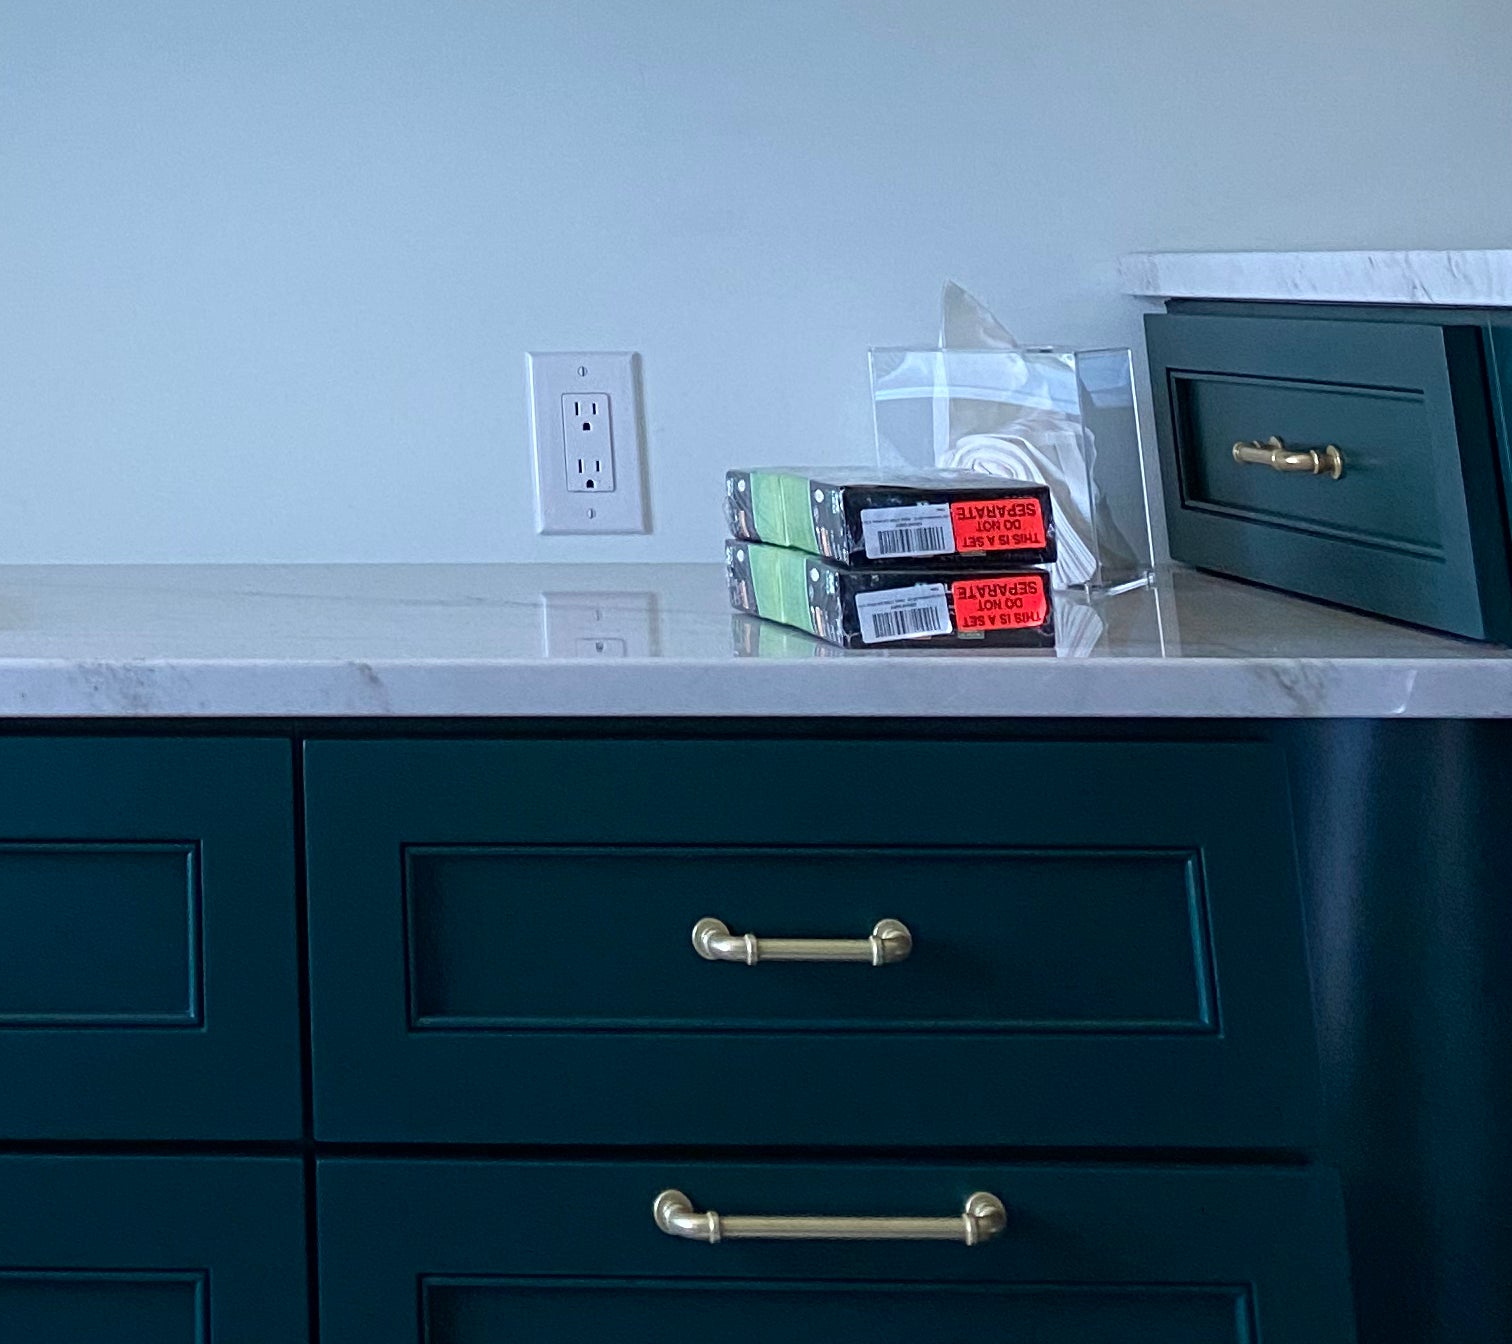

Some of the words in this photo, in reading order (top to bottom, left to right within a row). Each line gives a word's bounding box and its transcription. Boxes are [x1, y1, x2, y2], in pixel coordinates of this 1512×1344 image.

[956, 502, 1036, 520] SEPARATE
[975, 520, 1001, 531] NOT
[1005, 519, 1022, 530] DO
[962, 535, 985, 548] SET
[988, 535, 996, 546] A
[998, 534, 1010, 545] IS
[1013, 532, 1041, 545] THIS
[957, 581, 1037, 600] SEPARATE
[977, 599, 1002, 612] NOT
[1005, 598, 1023, 609] DO
[962, 615, 985, 628] SET
[988, 615, 996, 626] A
[999, 613, 1011, 625] IS
[1013, 611, 1041, 624] THIS
